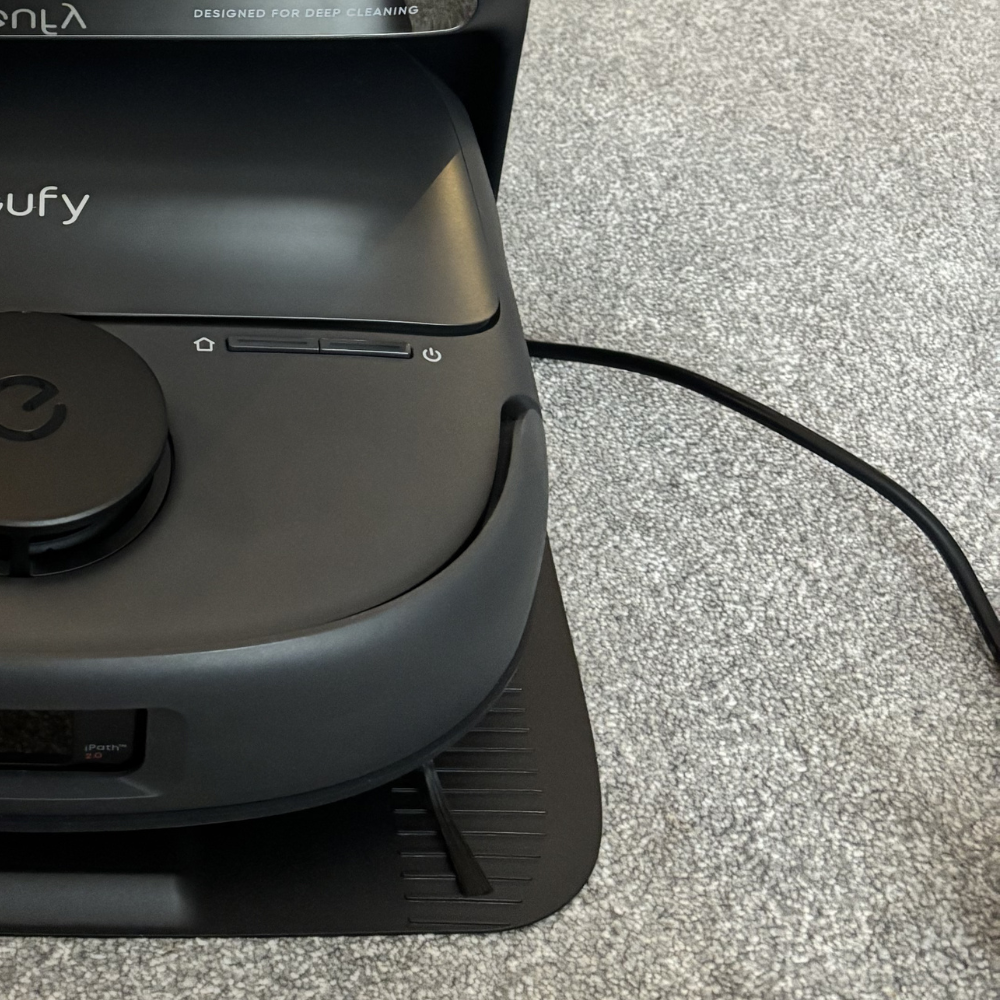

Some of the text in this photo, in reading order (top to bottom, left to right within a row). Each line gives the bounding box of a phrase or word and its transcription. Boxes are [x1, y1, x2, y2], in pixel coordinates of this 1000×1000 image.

[193, 5, 419, 18] DESIGNED FOR DEEP CLEANING
